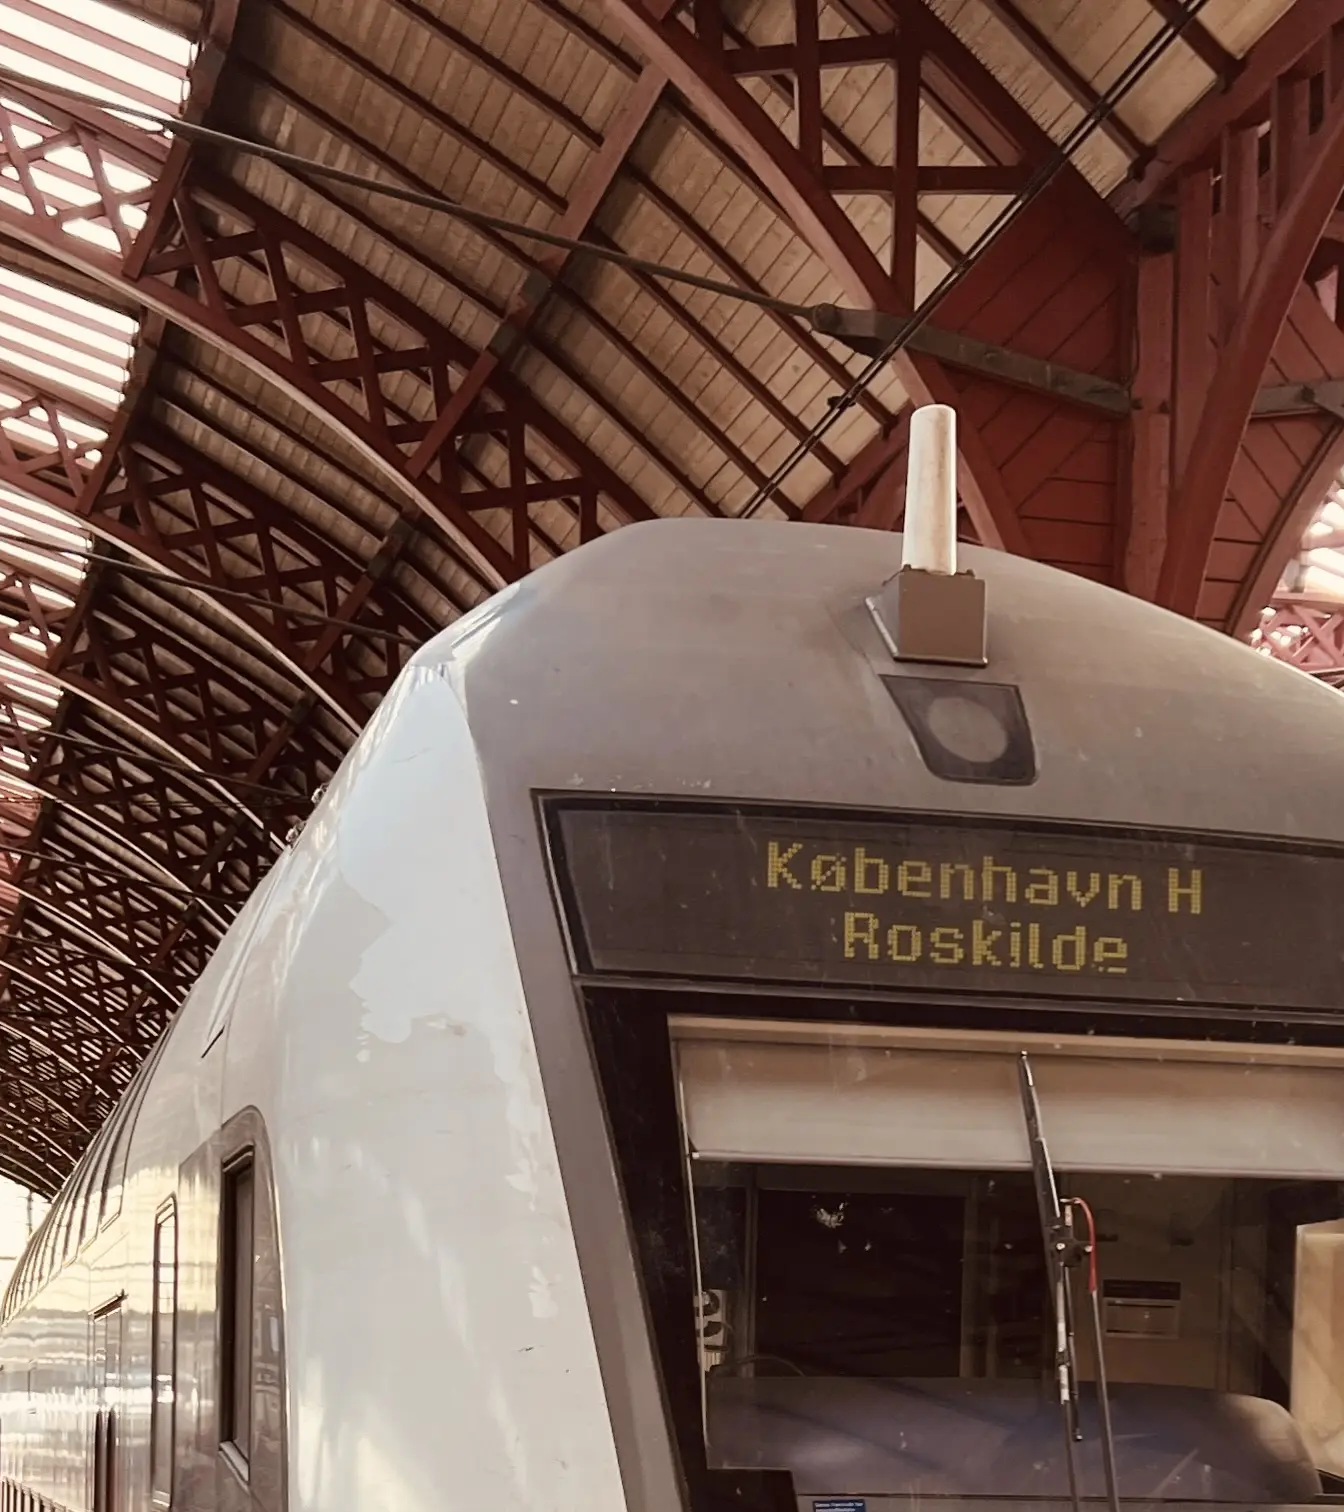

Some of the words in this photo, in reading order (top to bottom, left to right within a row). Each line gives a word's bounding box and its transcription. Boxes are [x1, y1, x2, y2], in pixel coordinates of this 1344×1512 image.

[766, 841, 1143, 913] København
[1168, 868, 1203, 915] H
[843, 911, 1130, 974] Roskilde
